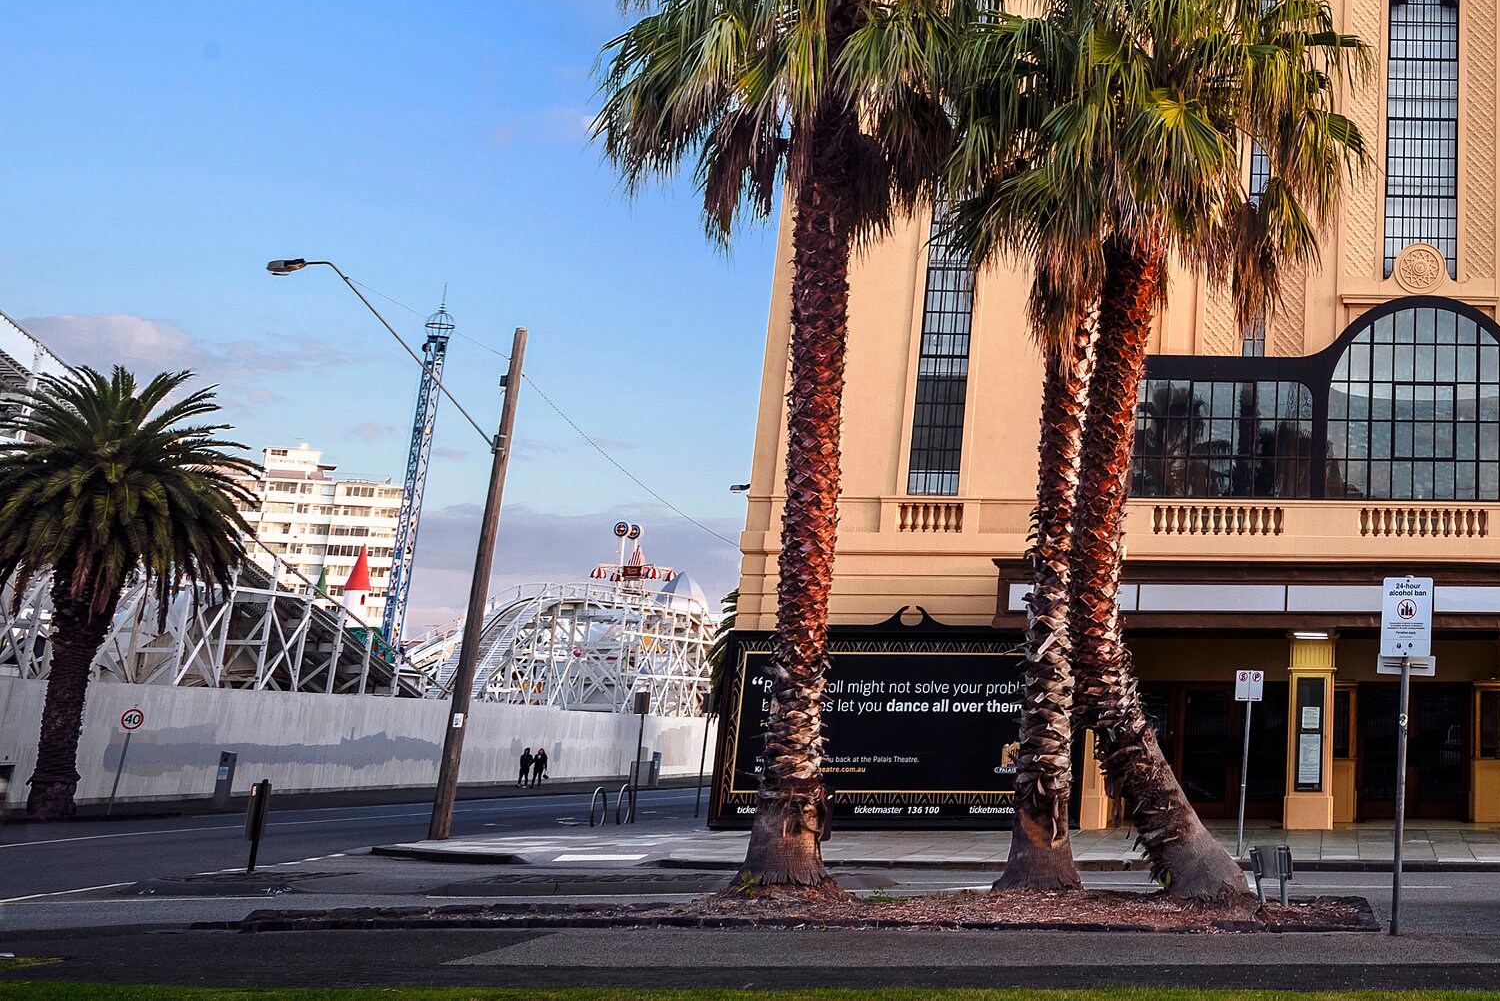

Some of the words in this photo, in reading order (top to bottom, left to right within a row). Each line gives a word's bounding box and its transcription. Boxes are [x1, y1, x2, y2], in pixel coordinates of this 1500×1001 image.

[848, 680, 886, 697] might
[888, 681, 911, 694] not
[914, 680, 950, 694] solve
[953, 683, 983, 697] your
[838, 699, 854, 712] let
[858, 701, 882, 716] you
[886, 699, 929, 713] dance
[932, 699, 949, 713] all
[952, 701, 983, 713] over
[124, 714, 141, 725] 40
[854, 805, 904, 814] ticketmaster
[907, 806, 923, 814] 136
[924, 806, 940, 814] 100
[969, 805, 1016, 814] ticketmaste
